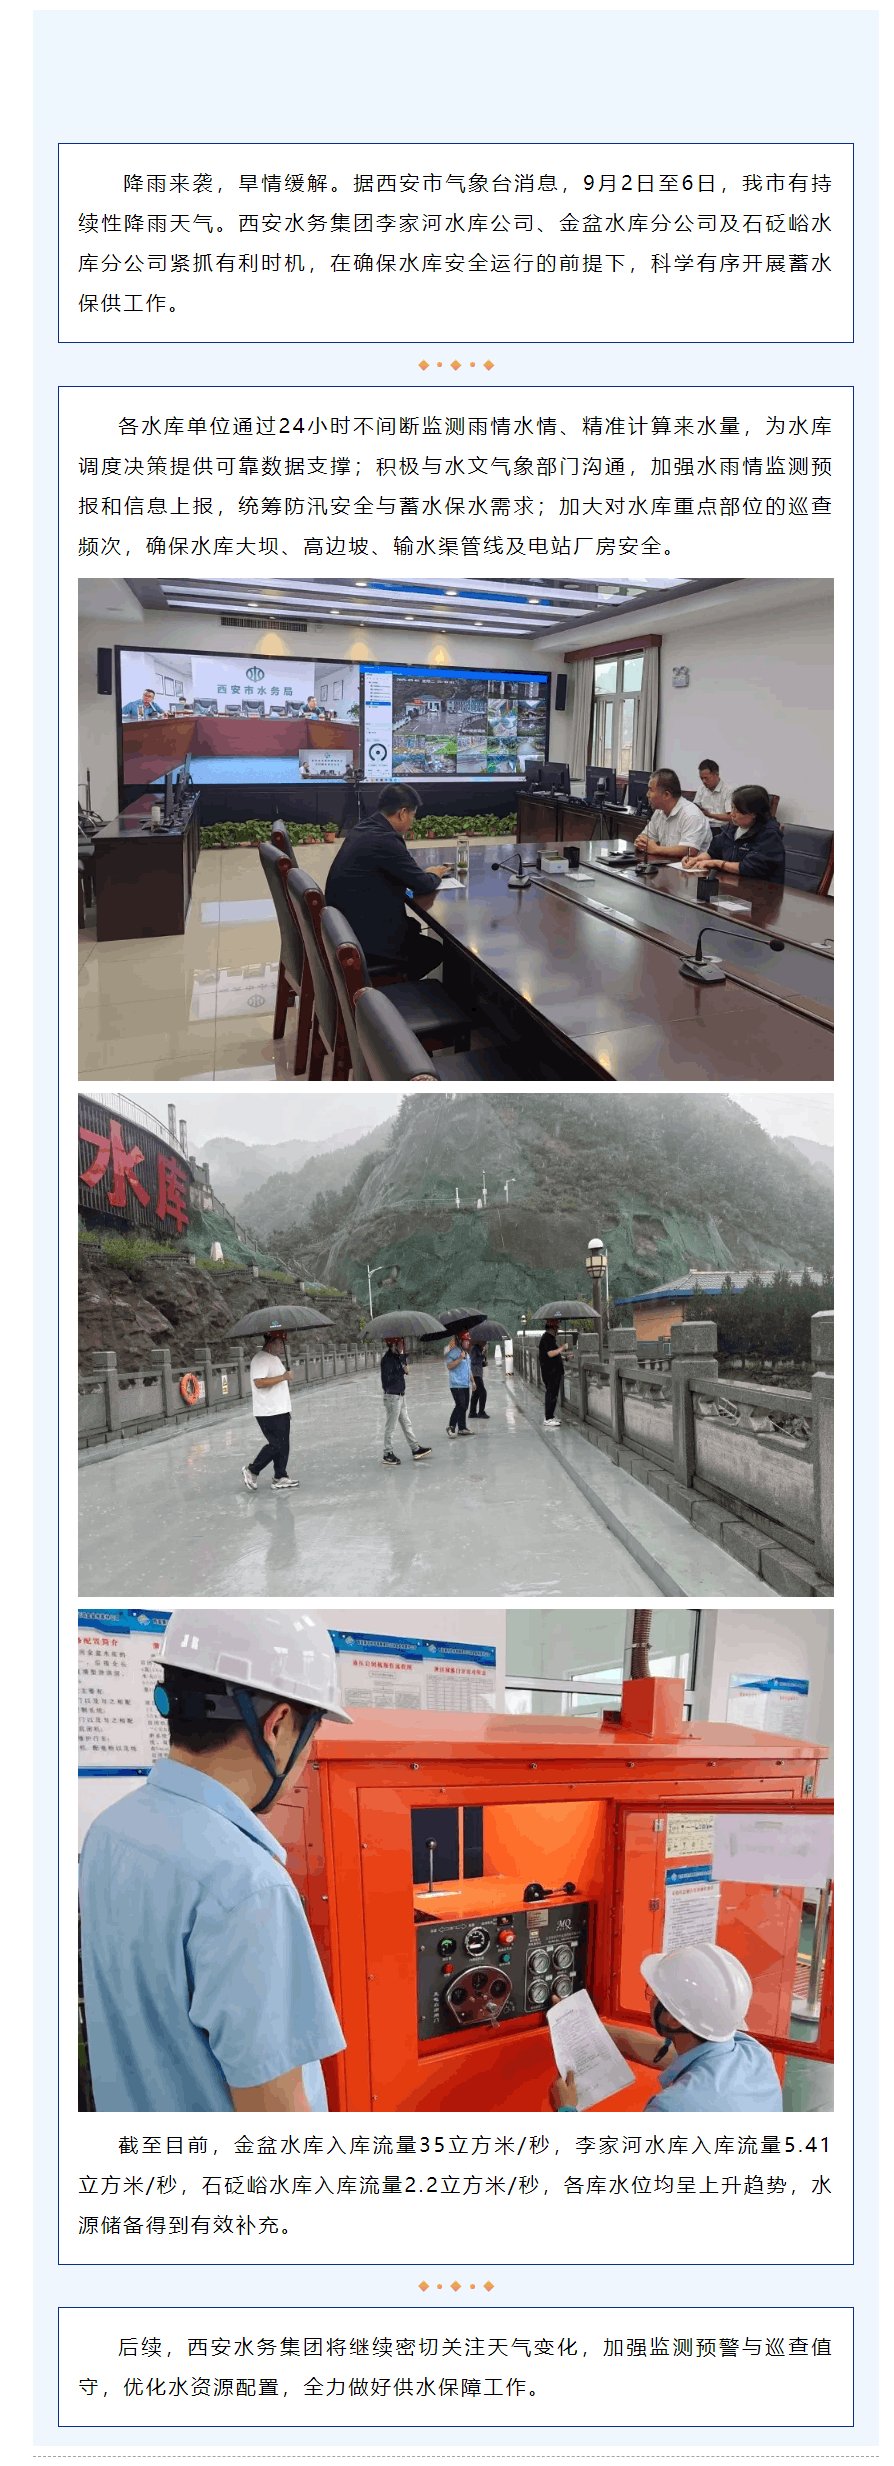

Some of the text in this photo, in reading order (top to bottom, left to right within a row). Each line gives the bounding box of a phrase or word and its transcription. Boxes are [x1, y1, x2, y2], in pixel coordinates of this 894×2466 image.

[124, 172, 832, 194] 降雨来袭，旱情缓解。据西安市气象台消息，9月2日至6日，我市有持
[78, 212, 832, 234] 续性降雨天气。西安水务集团李家河水库公司、金盆水库分公司及石砭峪水
[78, 252, 832, 274] 库分公司紧抓有利时机，在确保水库安全运行的前提下，科学有序开展蓄水
[78, 293, 178, 313] 保供工作。
[118, 415, 832, 437] 各水库单位通过24小时不间断监测雨情水情、精准计算来水量，为水库
[78, 455, 832, 477] 调度决策提供可靠数据支撑；积极与水文气象部门沟通，加强水雨情监测预
[78, 495, 832, 517] 报和信息上报，统筹防汛安全与蓄水保水需求；加大对水库重点部位的巡查
[78, 535, 676, 557] 频次，确保水库大坝、高边坡、输水渠管线及电站厂房安全。
[217, 684, 293, 697] 西安市水务局
[79, 1119, 190, 1233] 水库
[118, 2134, 831, 2156] 截至目前，金盆水库入库流量35立方米/秒，李家河水库入库流量5.41
[78, 2174, 832, 2196] 立方米/秒，石砭峪水库入库流量2.2立方米/秒，各库水位均呈上升趋势，水
[78, 2214, 290, 2236] 源储备得到有效补充。
[118, 2336, 832, 2358] 后续，西安水务集团将继续密切关注天气变化，加强监测预警与巡查值
[78, 2376, 538, 2398] 守，优化水资源配置，全力做好供水保障工作。
